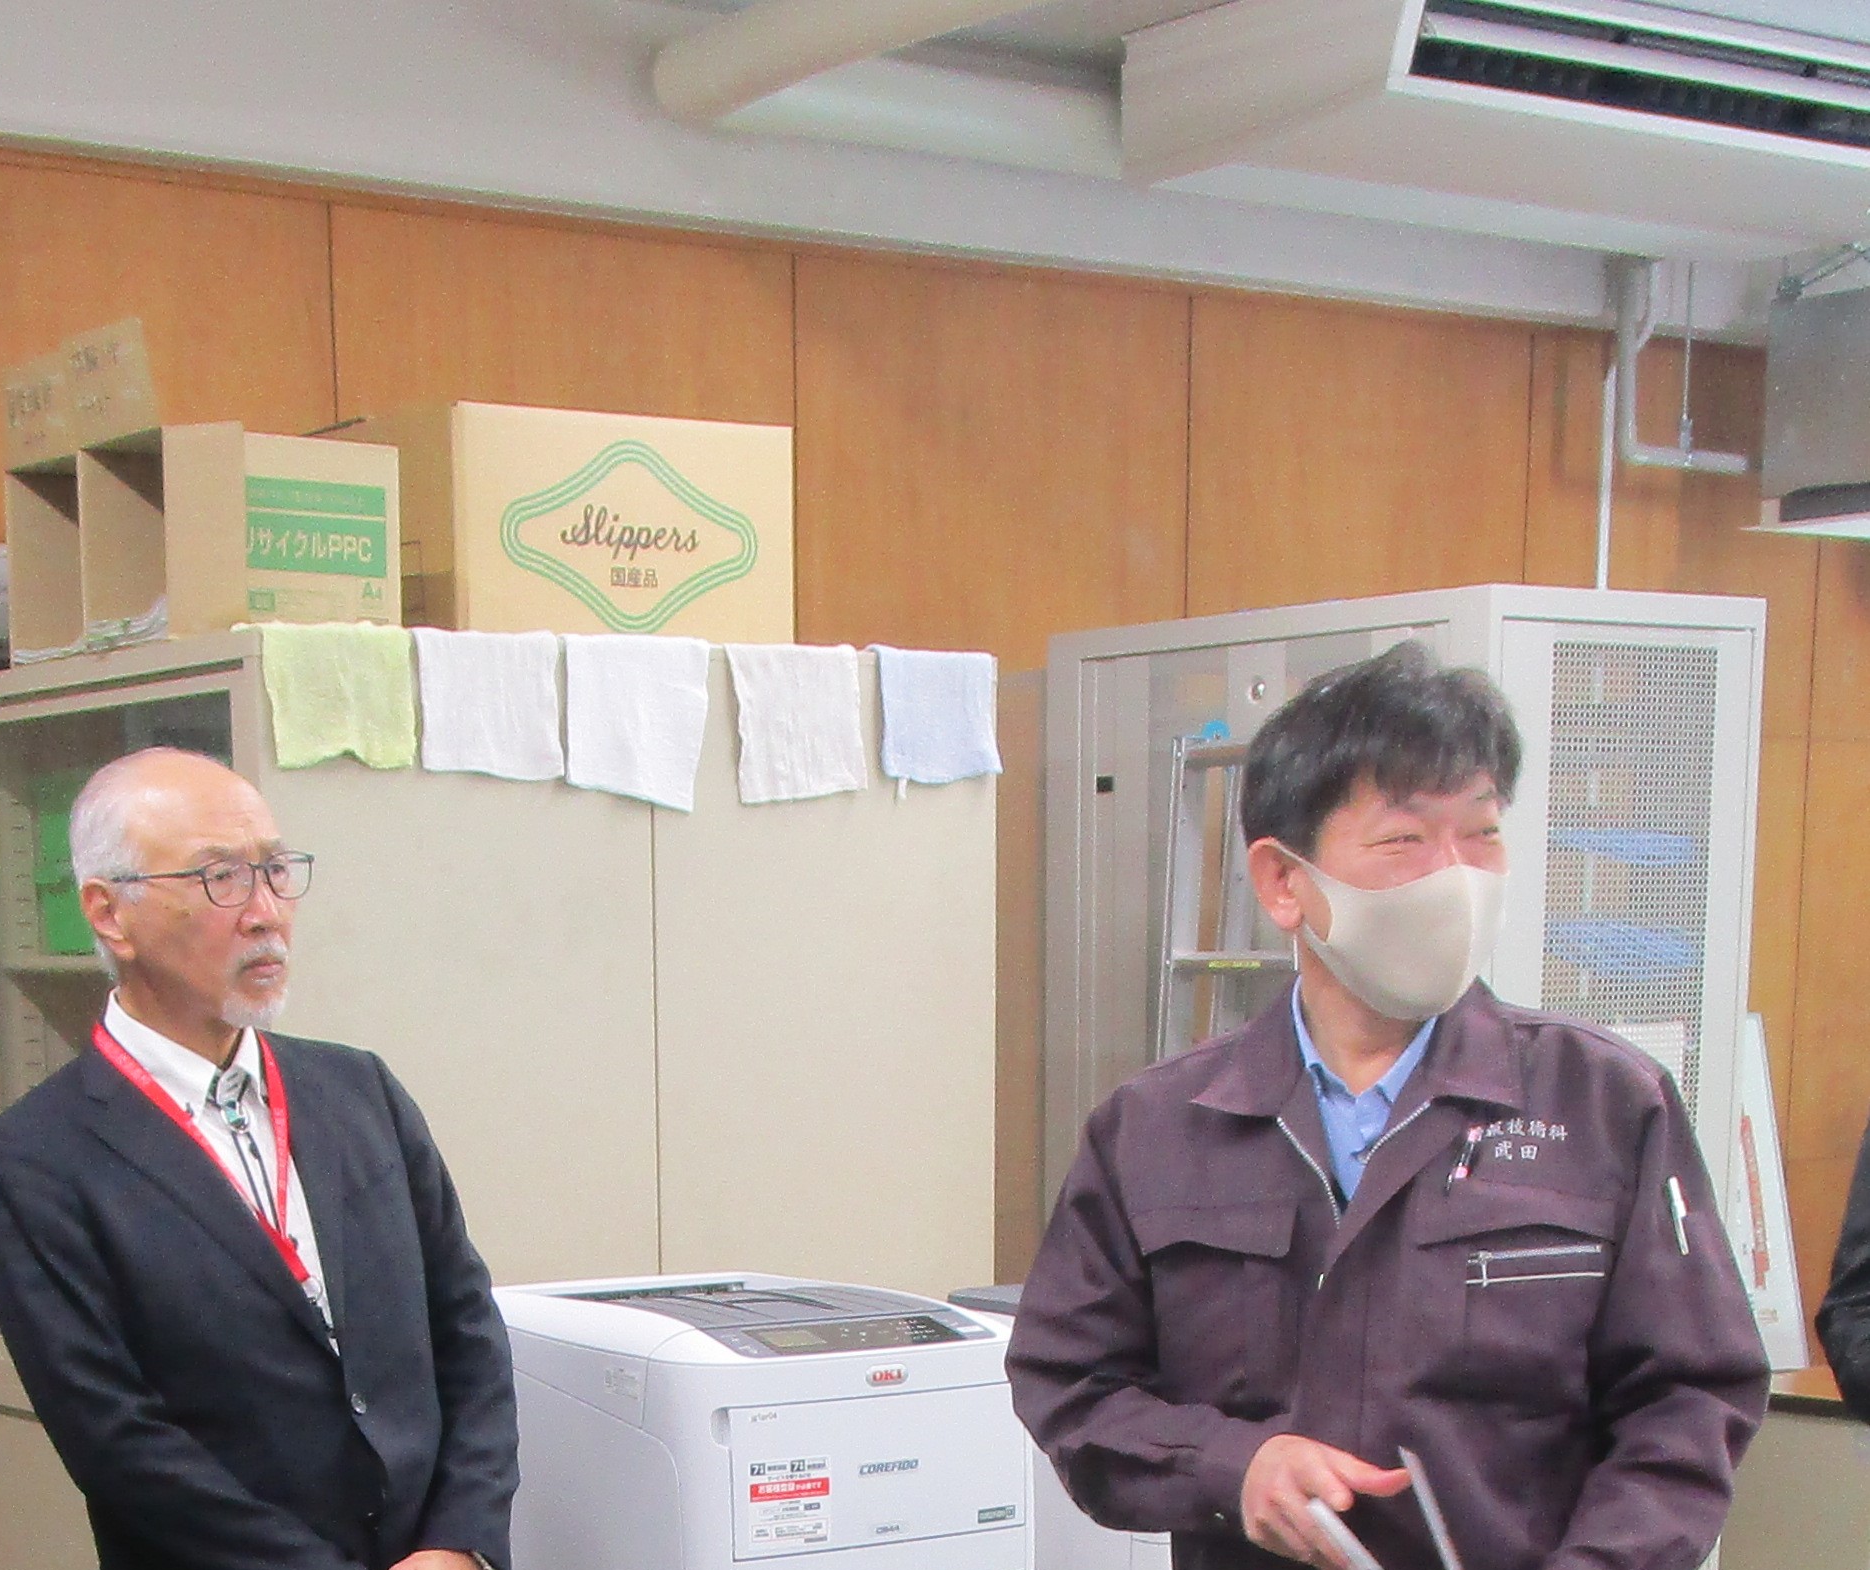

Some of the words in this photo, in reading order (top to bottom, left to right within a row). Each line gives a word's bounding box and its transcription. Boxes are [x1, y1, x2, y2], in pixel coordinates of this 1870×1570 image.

[560, 503, 701, 562] Slippers
[610, 566, 659, 588] 国産品
[1494, 1140, 1538, 1160] 武田
[871, 1368, 903, 1384] OKI
